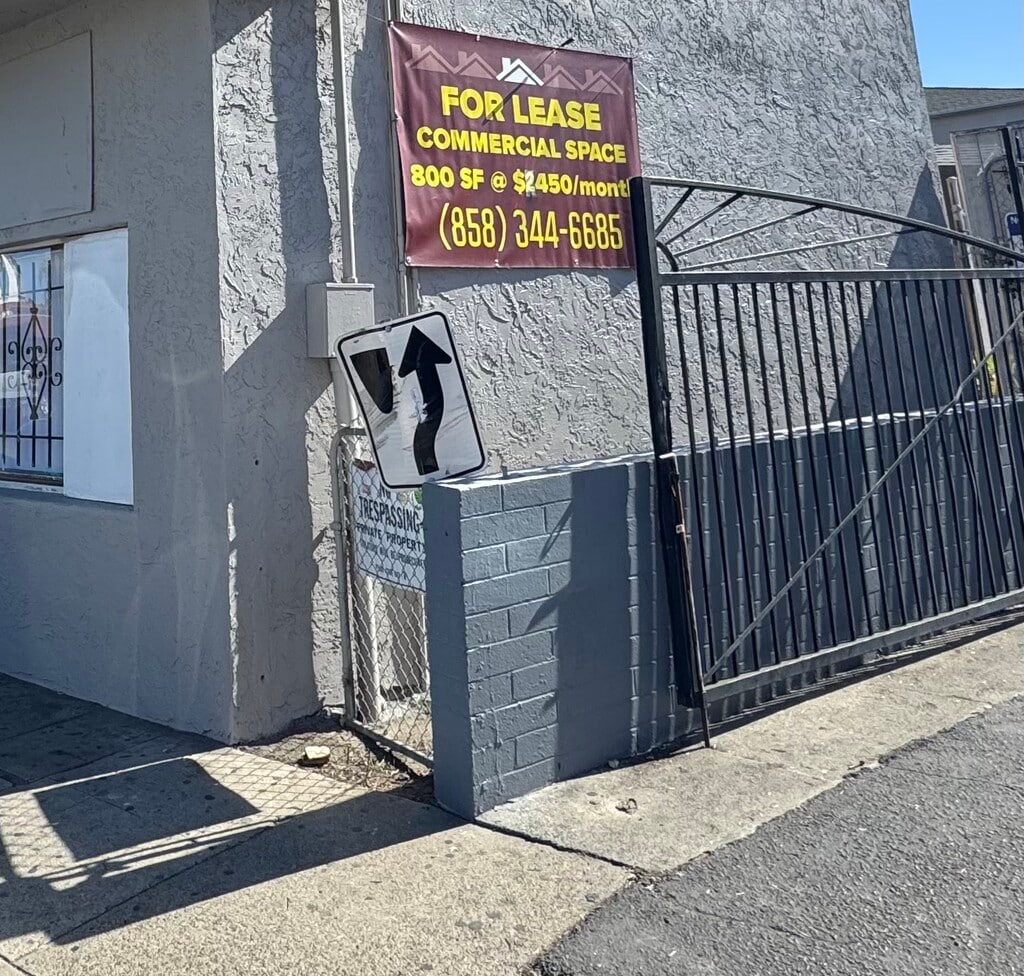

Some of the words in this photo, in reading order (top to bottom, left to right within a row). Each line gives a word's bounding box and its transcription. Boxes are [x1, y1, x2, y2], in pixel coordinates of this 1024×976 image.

[440, 85, 505, 122] FOR
[512, 94, 602, 131] LEASE
[416, 126, 562, 159] COMMERCIAL
[564, 139, 627, 164] SPACE
[410, 163, 455, 189] 800
[459, 167, 485, 191] SF
[490, 171, 507, 193] @
[512, 168, 631, 198] $2450/mont
[439, 202, 507, 252] (858)
[513, 209, 624, 251] 344-6685
[356, 523, 383, 541] PRIVATE
[359, 495, 424, 534] TRESPASSING
